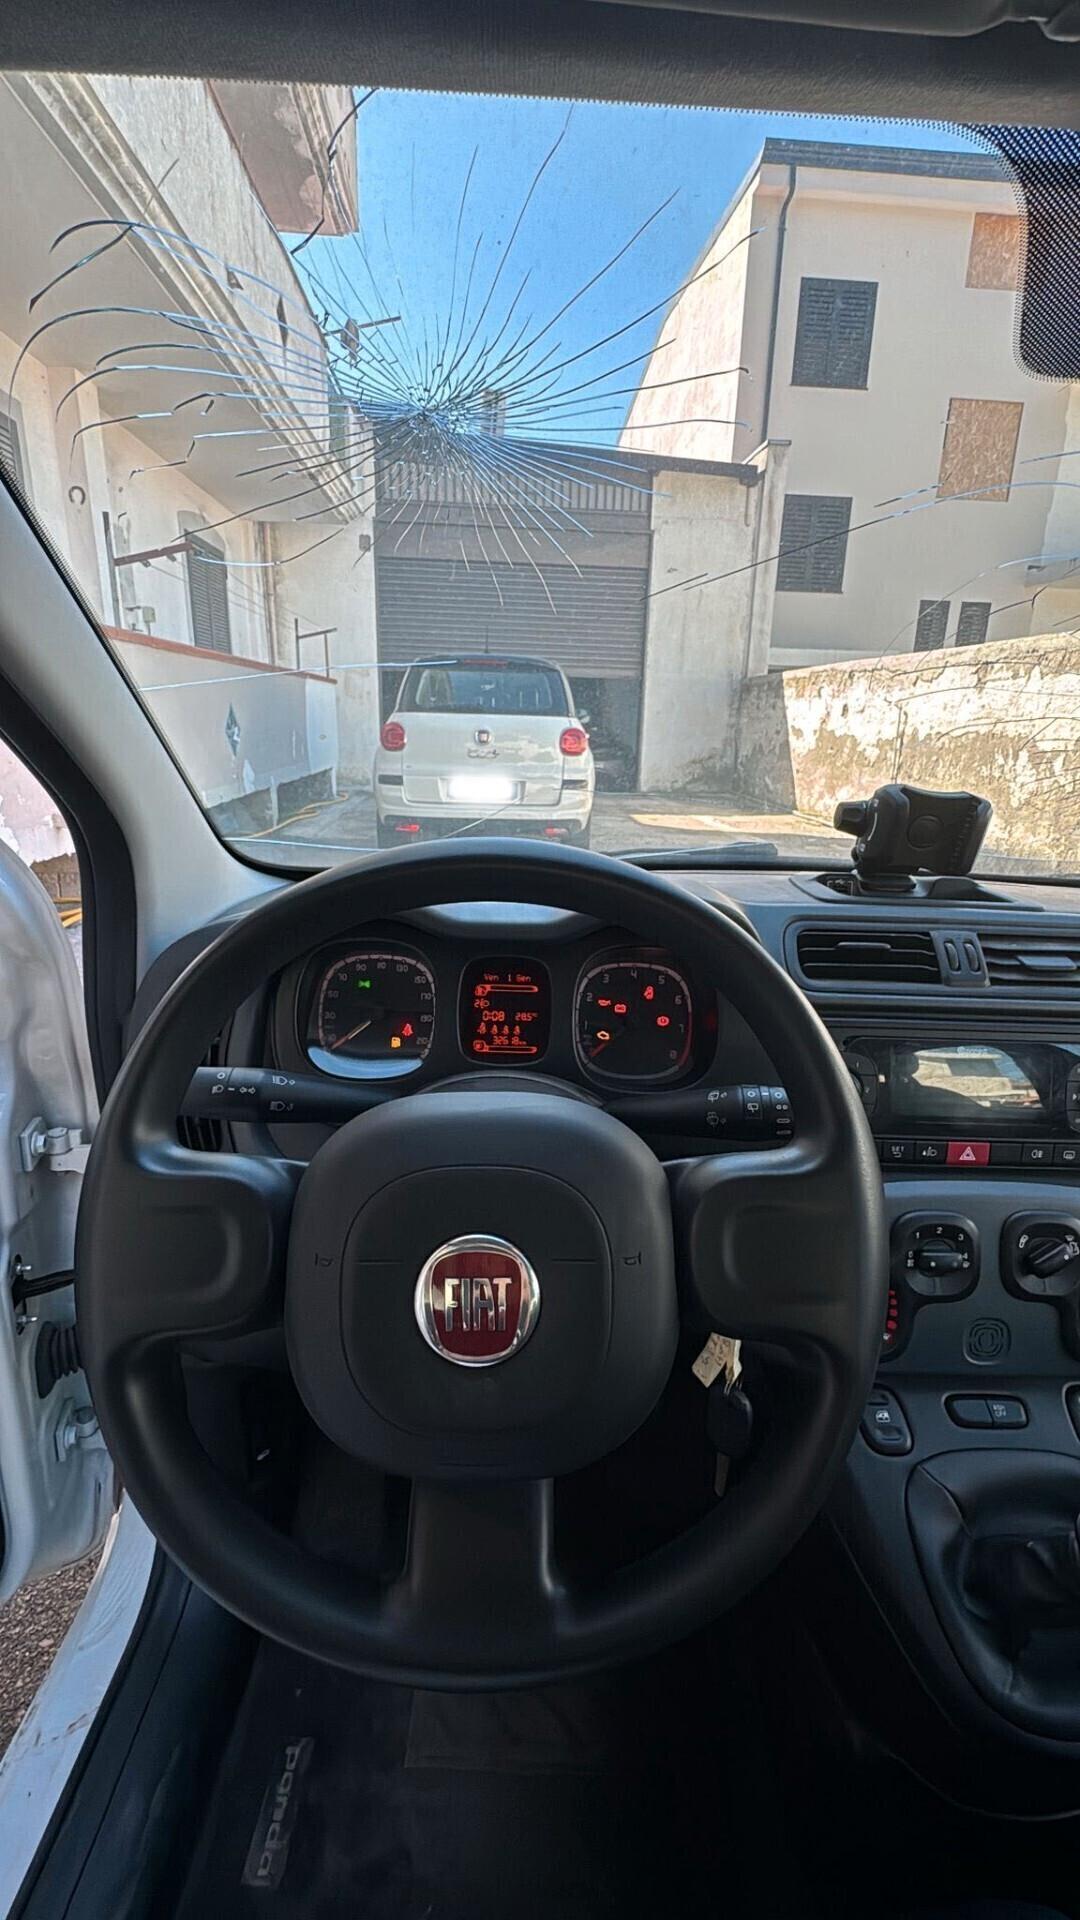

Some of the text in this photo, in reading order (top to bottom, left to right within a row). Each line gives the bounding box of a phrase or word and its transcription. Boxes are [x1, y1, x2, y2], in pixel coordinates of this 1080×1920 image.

[338, 972, 348, 981] 70
[602, 973, 610, 983] 3
[630, 969, 638, 979] 4
[658, 975, 665, 985] 5
[586, 992, 593, 1002] 2
[674, 995, 682, 1005] 6
[936, 1226, 943, 1234] 2
[957, 1233, 964, 1241] 3
[444, 1277, 512, 1332] FIAT
[256, 1745, 301, 1877] panda
